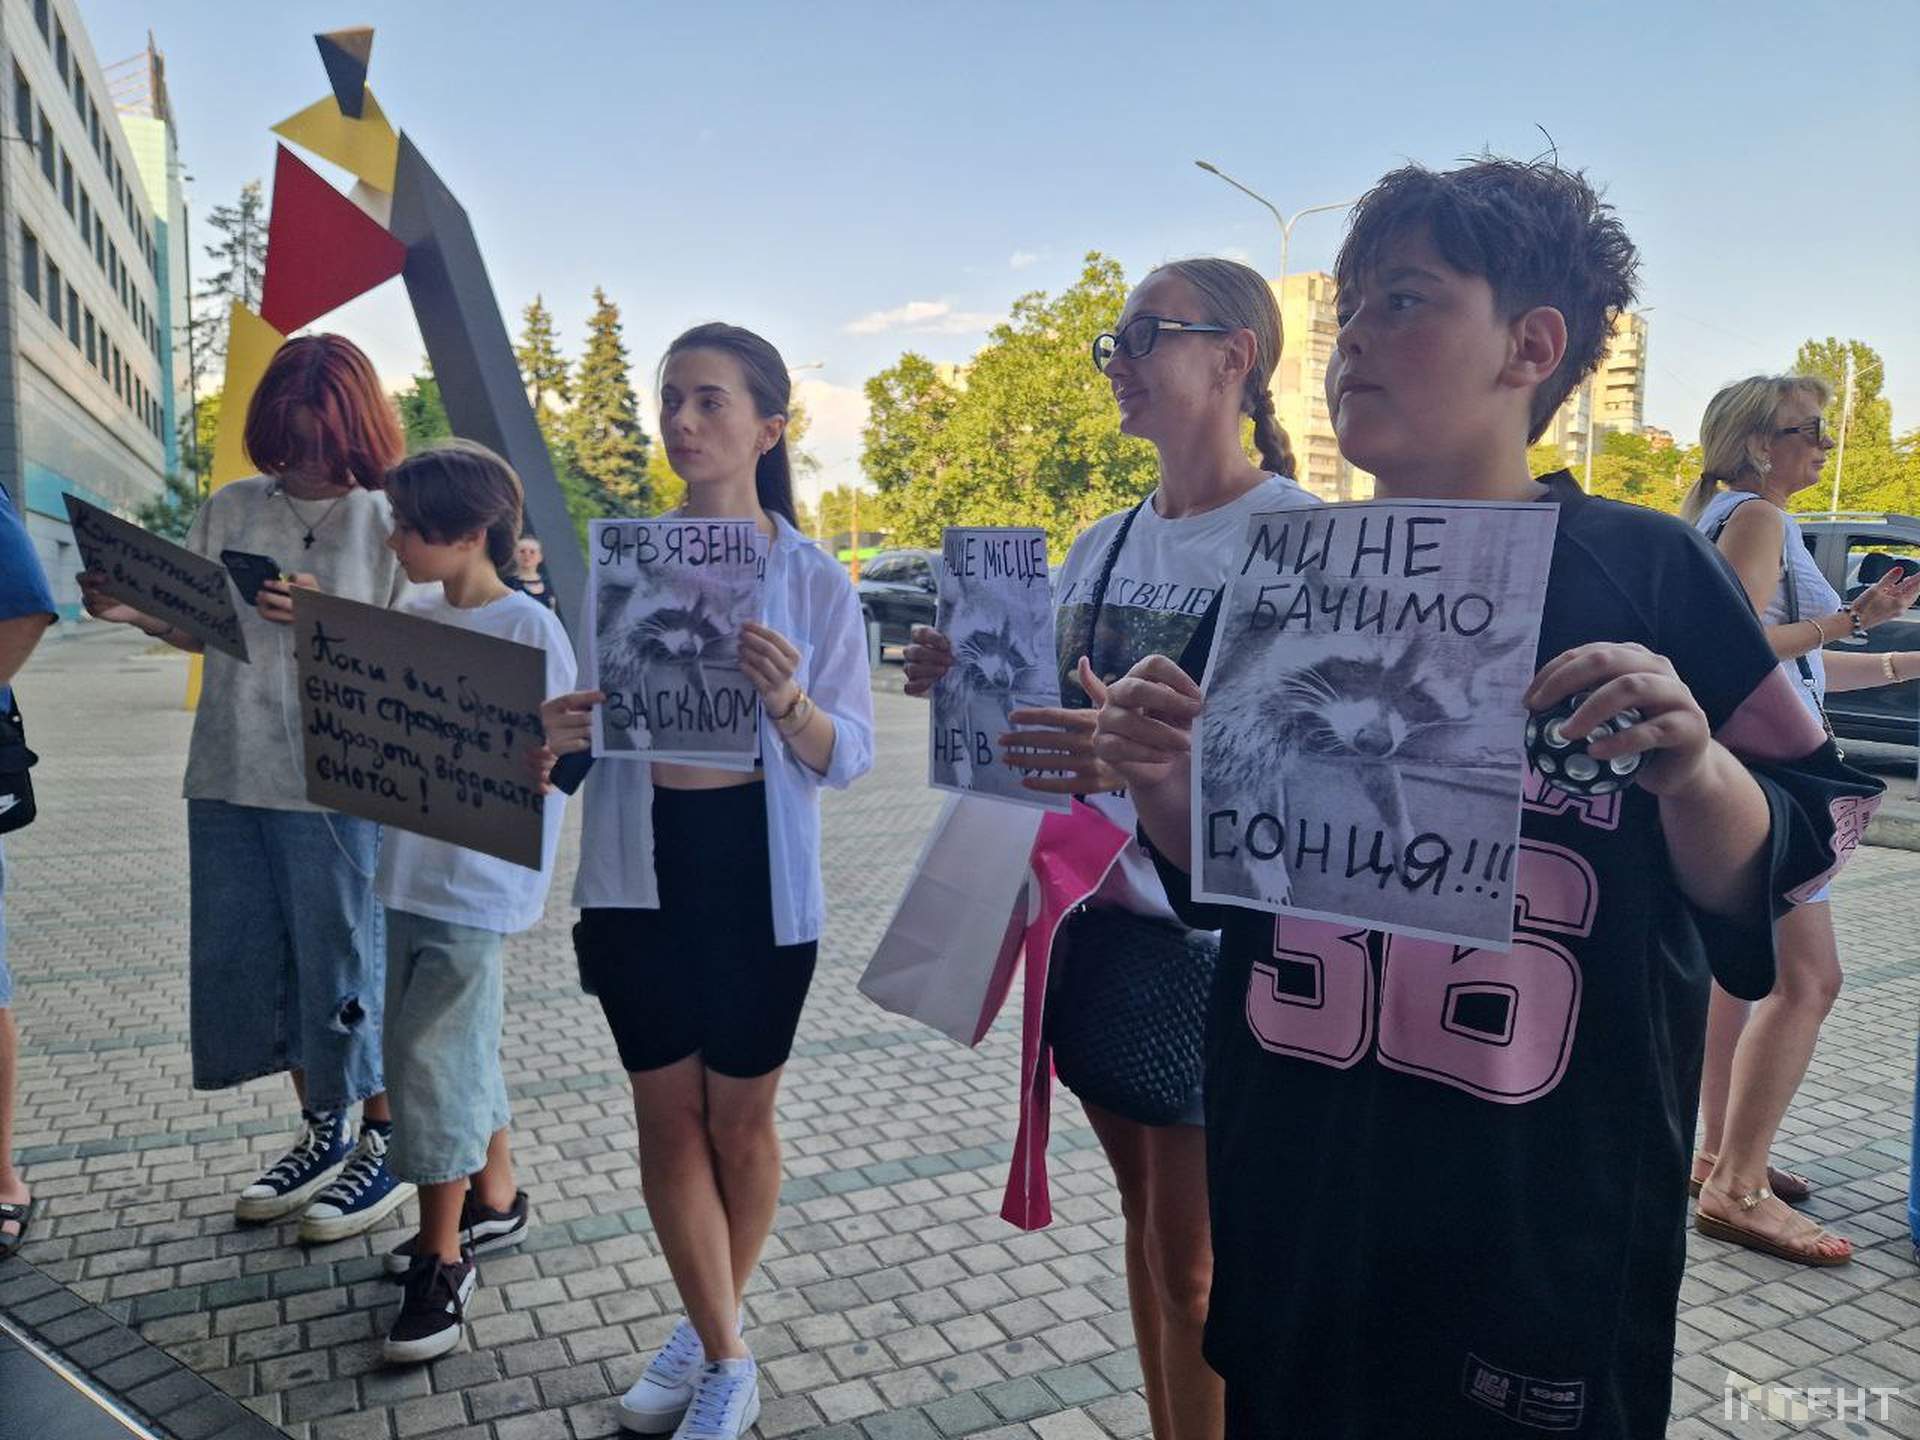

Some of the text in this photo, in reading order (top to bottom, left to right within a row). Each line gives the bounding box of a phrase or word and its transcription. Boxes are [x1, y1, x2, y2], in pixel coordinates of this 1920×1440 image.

[1240, 514, 1447, 578] МИ НЕ
[1250, 583, 1495, 637] БАЧИМО
[608, 684, 758, 734] ЗА СКЛОМ
[933, 726, 964, 764] НЕ
[976, 731, 993, 766] В
[1208, 808, 1515, 900] СОНЦЯ!!!
